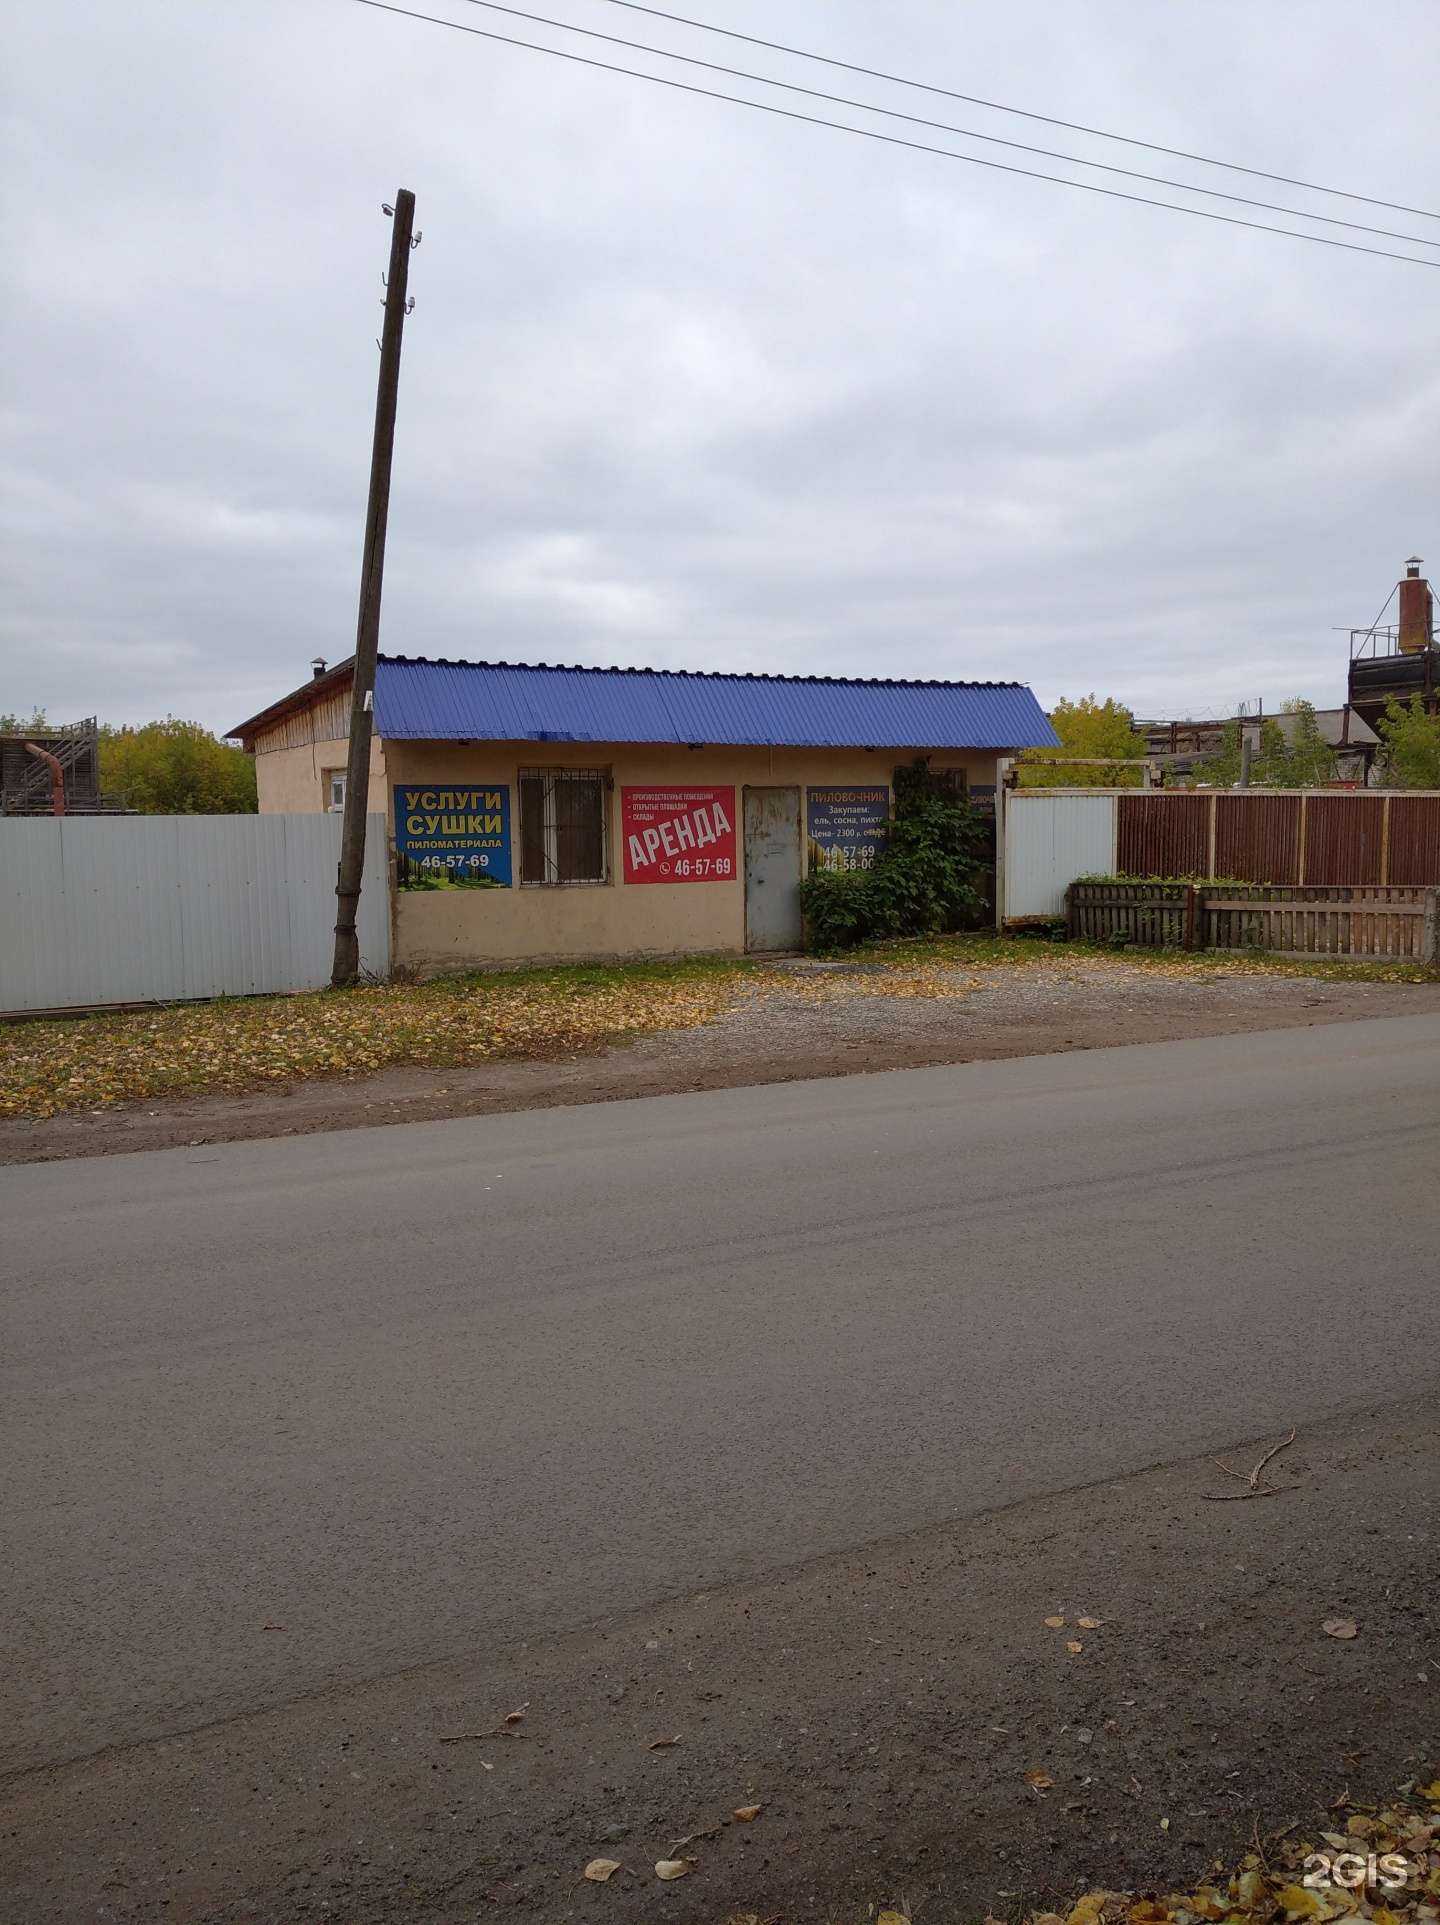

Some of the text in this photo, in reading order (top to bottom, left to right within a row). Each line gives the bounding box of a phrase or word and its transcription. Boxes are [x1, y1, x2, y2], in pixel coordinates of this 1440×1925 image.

[405, 792, 501, 810] УСЛУГИ
[810, 792, 885, 803] ПИЛОВОЧНИК
[406, 815, 502, 835] СУШКИ
[628, 801, 732, 871] АРЕНДА
[407, 840, 502, 849] ПИЛОМАТЕРИАЛА
[823, 846, 875, 858] 4657-69
[421, 854, 489, 868] 46-57-69
[674, 858, 731, 876] 46-57-69
